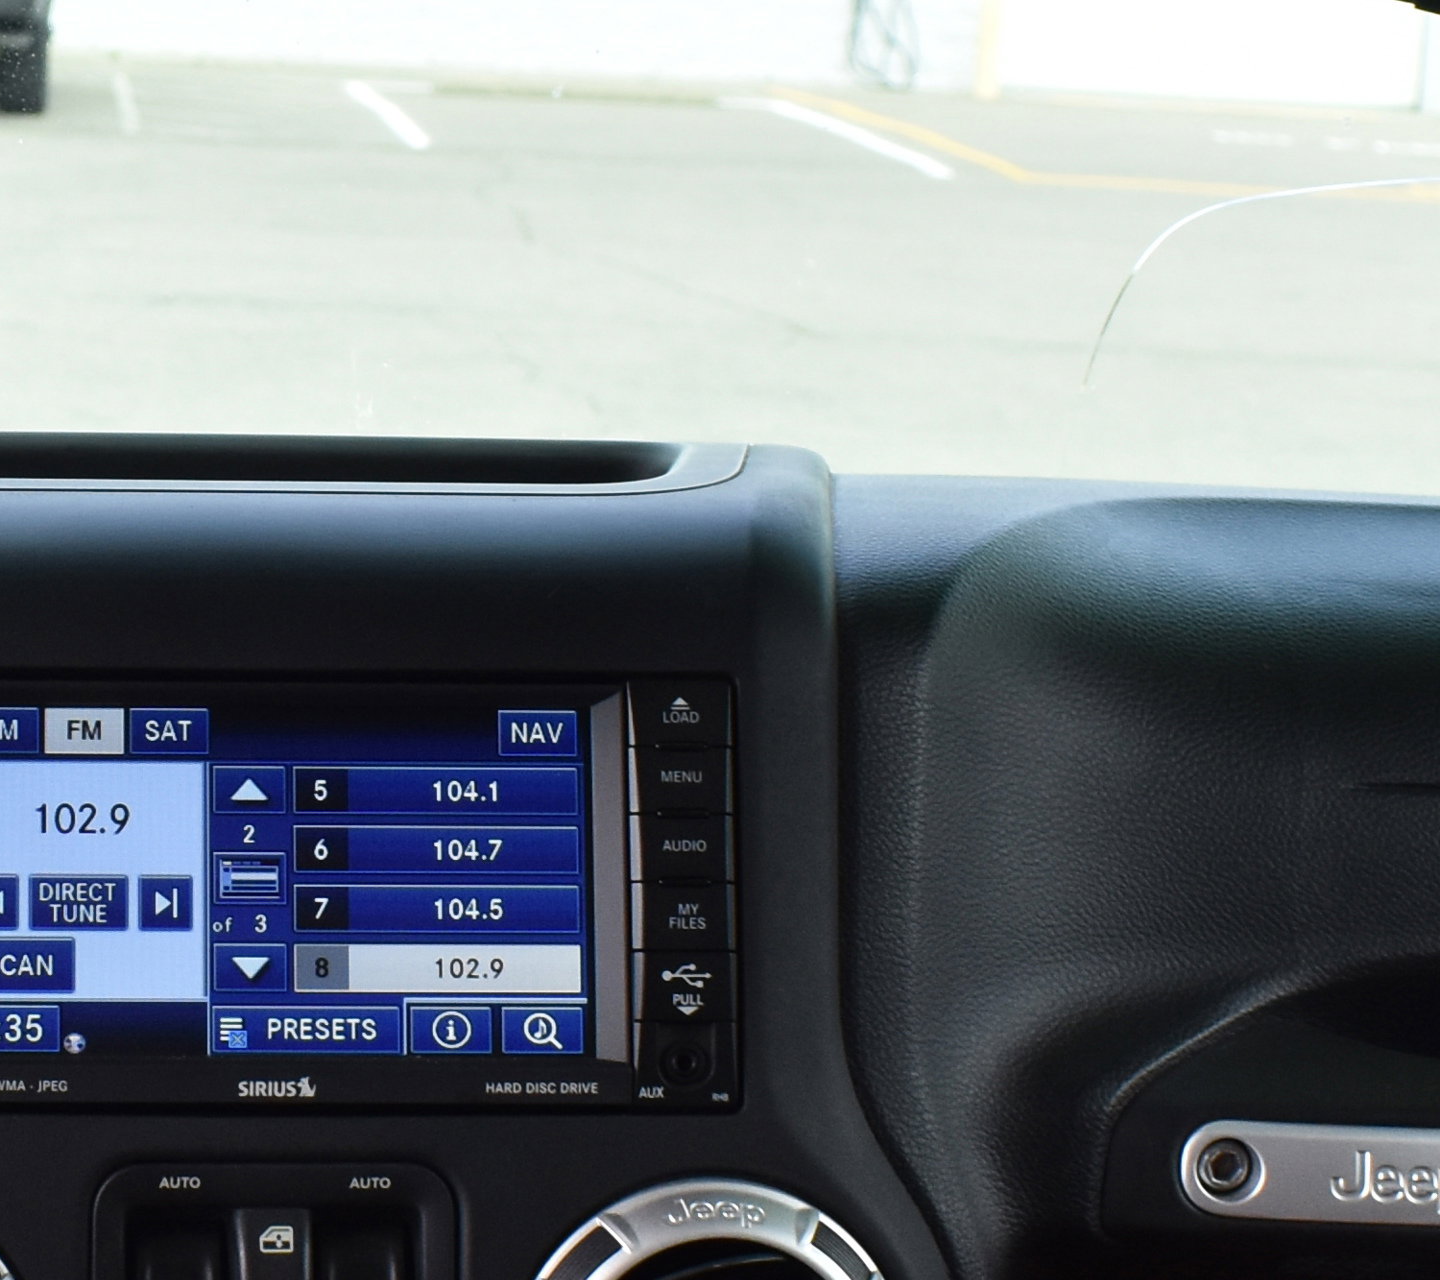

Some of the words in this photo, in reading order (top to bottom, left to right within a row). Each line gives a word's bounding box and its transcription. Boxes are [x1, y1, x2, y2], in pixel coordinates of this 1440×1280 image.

[662, 710, 700, 724] LOAD
[66, 720, 103, 741] FM
[145, 720, 192, 742] SAT
[511, 722, 563, 744] NAV
[660, 770, 703, 784] MENU
[313, 780, 328, 801] 5
[432, 780, 500, 801] 104.1
[35, 803, 130, 835] 102.9
[243, 825, 256, 843] 2
[314, 840, 328, 860] 6
[433, 840, 503, 861] 104.7
[662, 839, 708, 853] AUDIO
[38, 882, 116, 902] DIRECT
[49, 904, 108, 923] TUNE
[314, 898, 329, 919] 7
[434, 899, 504, 920] 104.5
[678, 904, 700, 916] MY
[213, 916, 233, 933] of
[254, 915, 268, 933] 3
[669, 917, 707, 930] FILES
[314, 958, 329, 979] 8
[435, 958, 505, 979] 102.9
[672, 994, 705, 1007] PULL
[267, 1018, 377, 1041] PRESETS
[37, 1080, 68, 1093] JPEG
[238, 1080, 297, 1098] SIRIUS
[485, 1082, 522, 1095] HARD
[525, 1082, 558, 1095] DISC
[561, 1082, 599, 1095] DRIVE
[638, 1086, 665, 1099] AUX
[159, 1176, 201, 1189] AUTO
[349, 1177, 391, 1190] AUTO
[667, 1197, 767, 1229] Jeep
